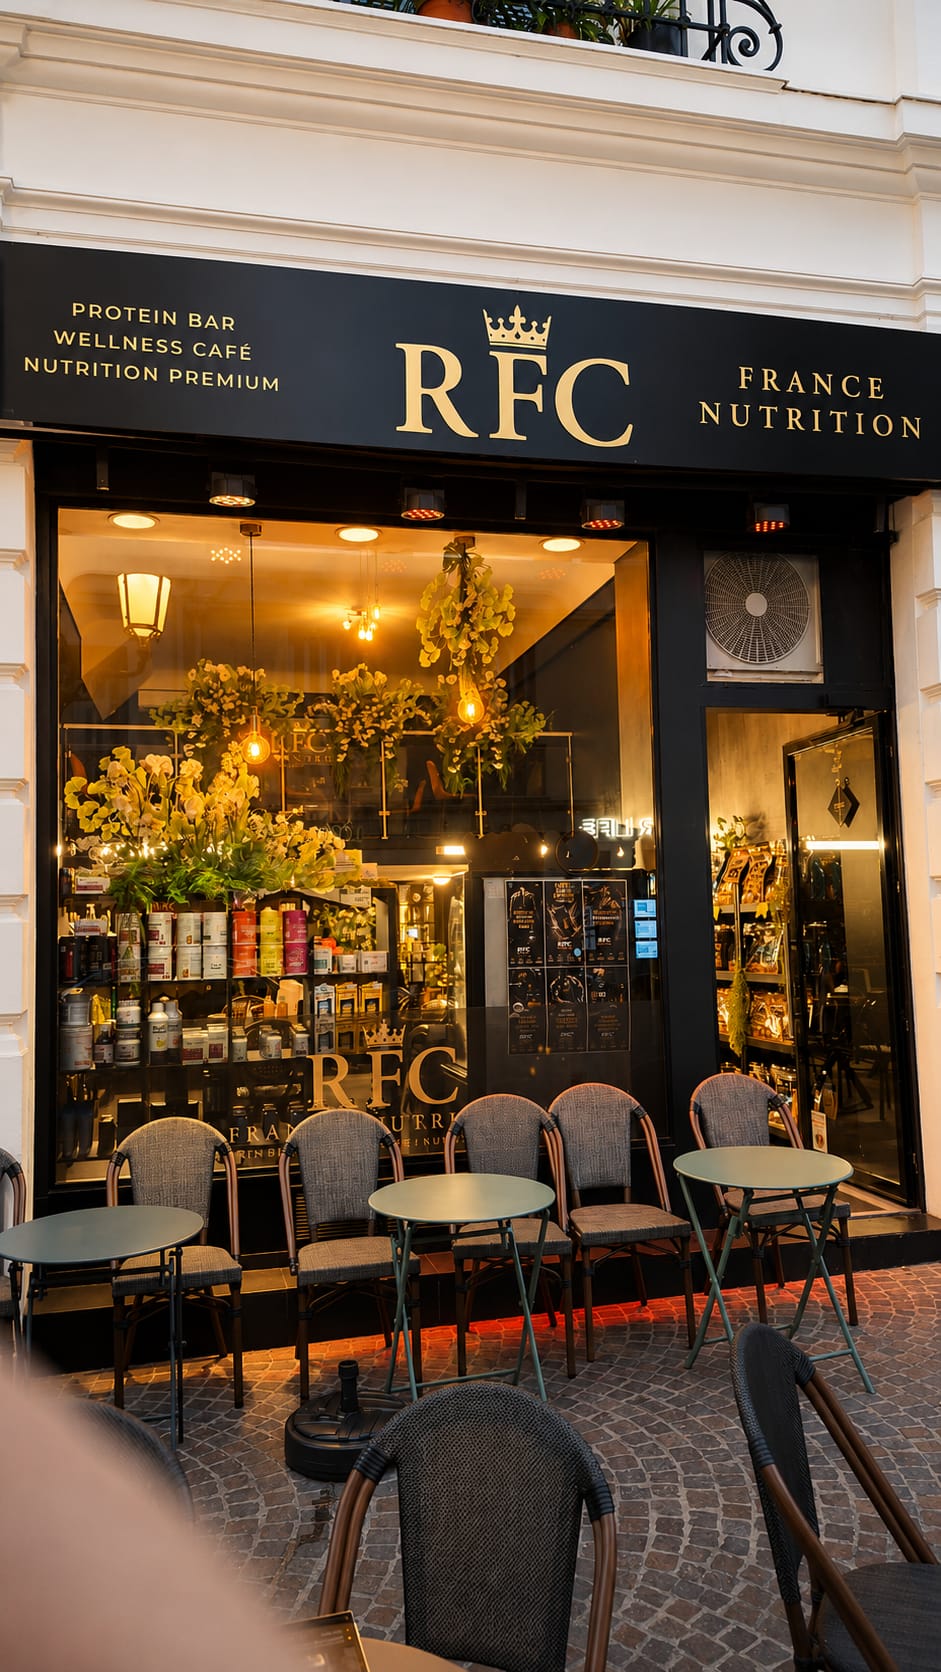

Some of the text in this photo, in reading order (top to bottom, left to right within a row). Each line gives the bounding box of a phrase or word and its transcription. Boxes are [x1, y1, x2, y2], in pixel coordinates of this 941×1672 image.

[72, 302, 235, 331] PROTEIN BAR
[53, 330, 252, 361] WELLNESS CAFÉ
[24, 356, 279, 392] NUTRITION PREMIUM
[738, 366, 884, 400] FRANCE
[395, 342, 634, 448] RFC
[698, 401, 921, 440] NUTRITION
[306, 1046, 459, 1112] RFC
